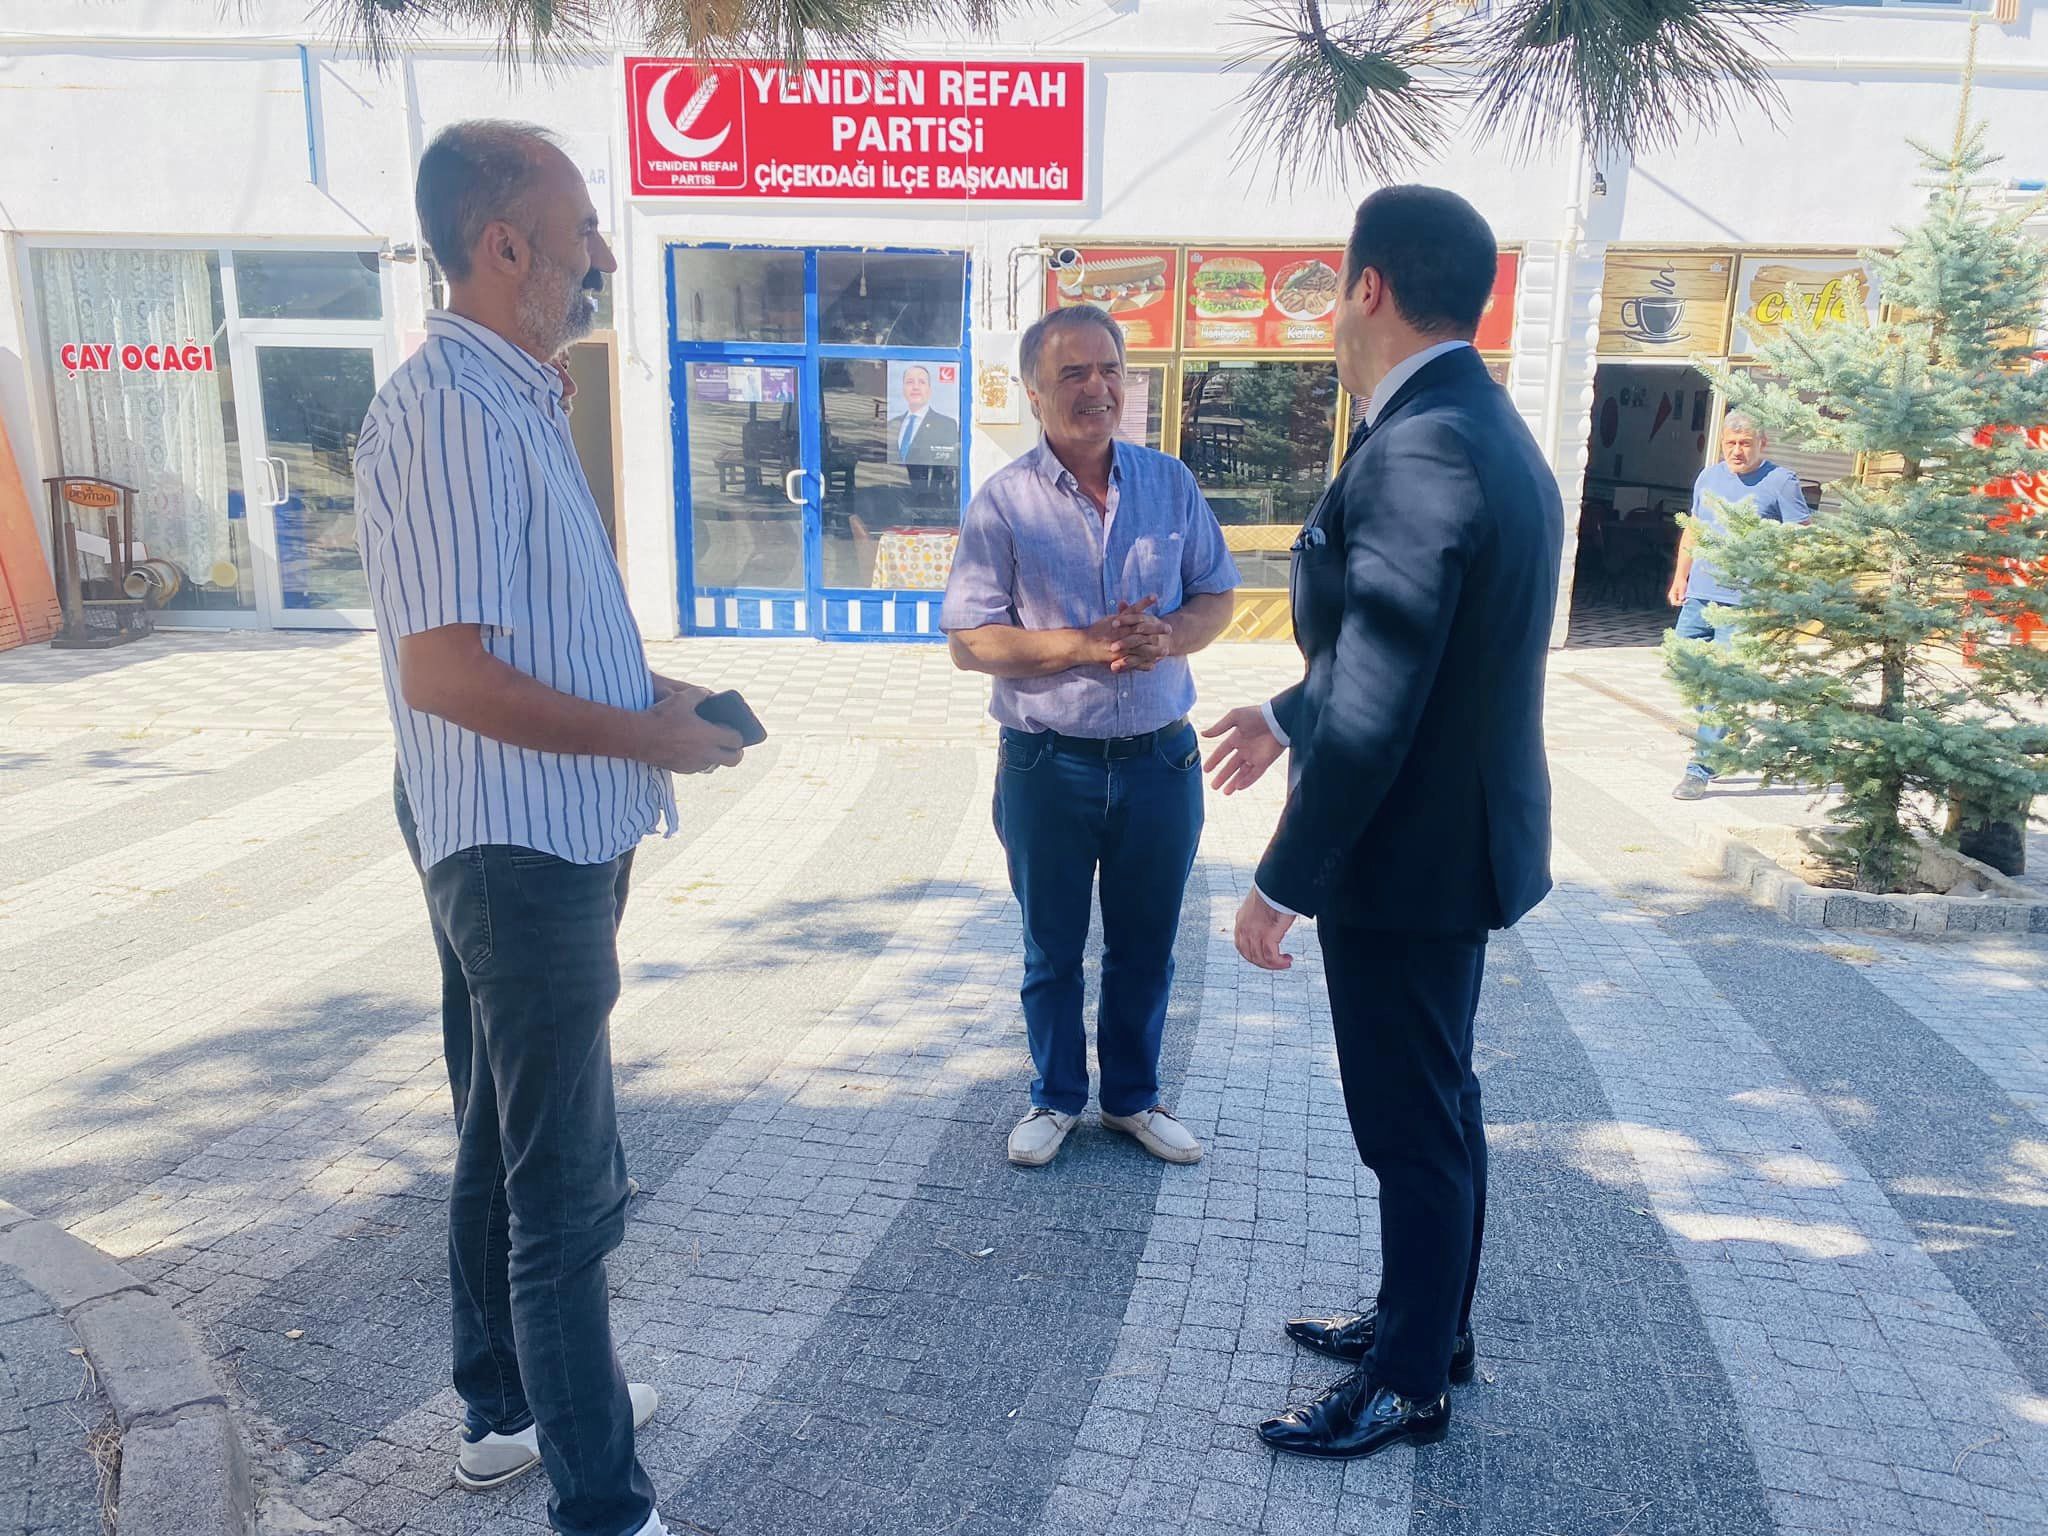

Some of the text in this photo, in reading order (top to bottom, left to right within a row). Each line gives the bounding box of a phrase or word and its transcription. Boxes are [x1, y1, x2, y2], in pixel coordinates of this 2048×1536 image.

[939, 69, 1066, 107] REFAH
[702, 161, 738, 171] REFAH
[754, 158, 1069, 195] ÇİÇEKDAĞI İLÇE BAŞKANLIĞI
[61, 338, 214, 379] ÇAY OCAĞI
